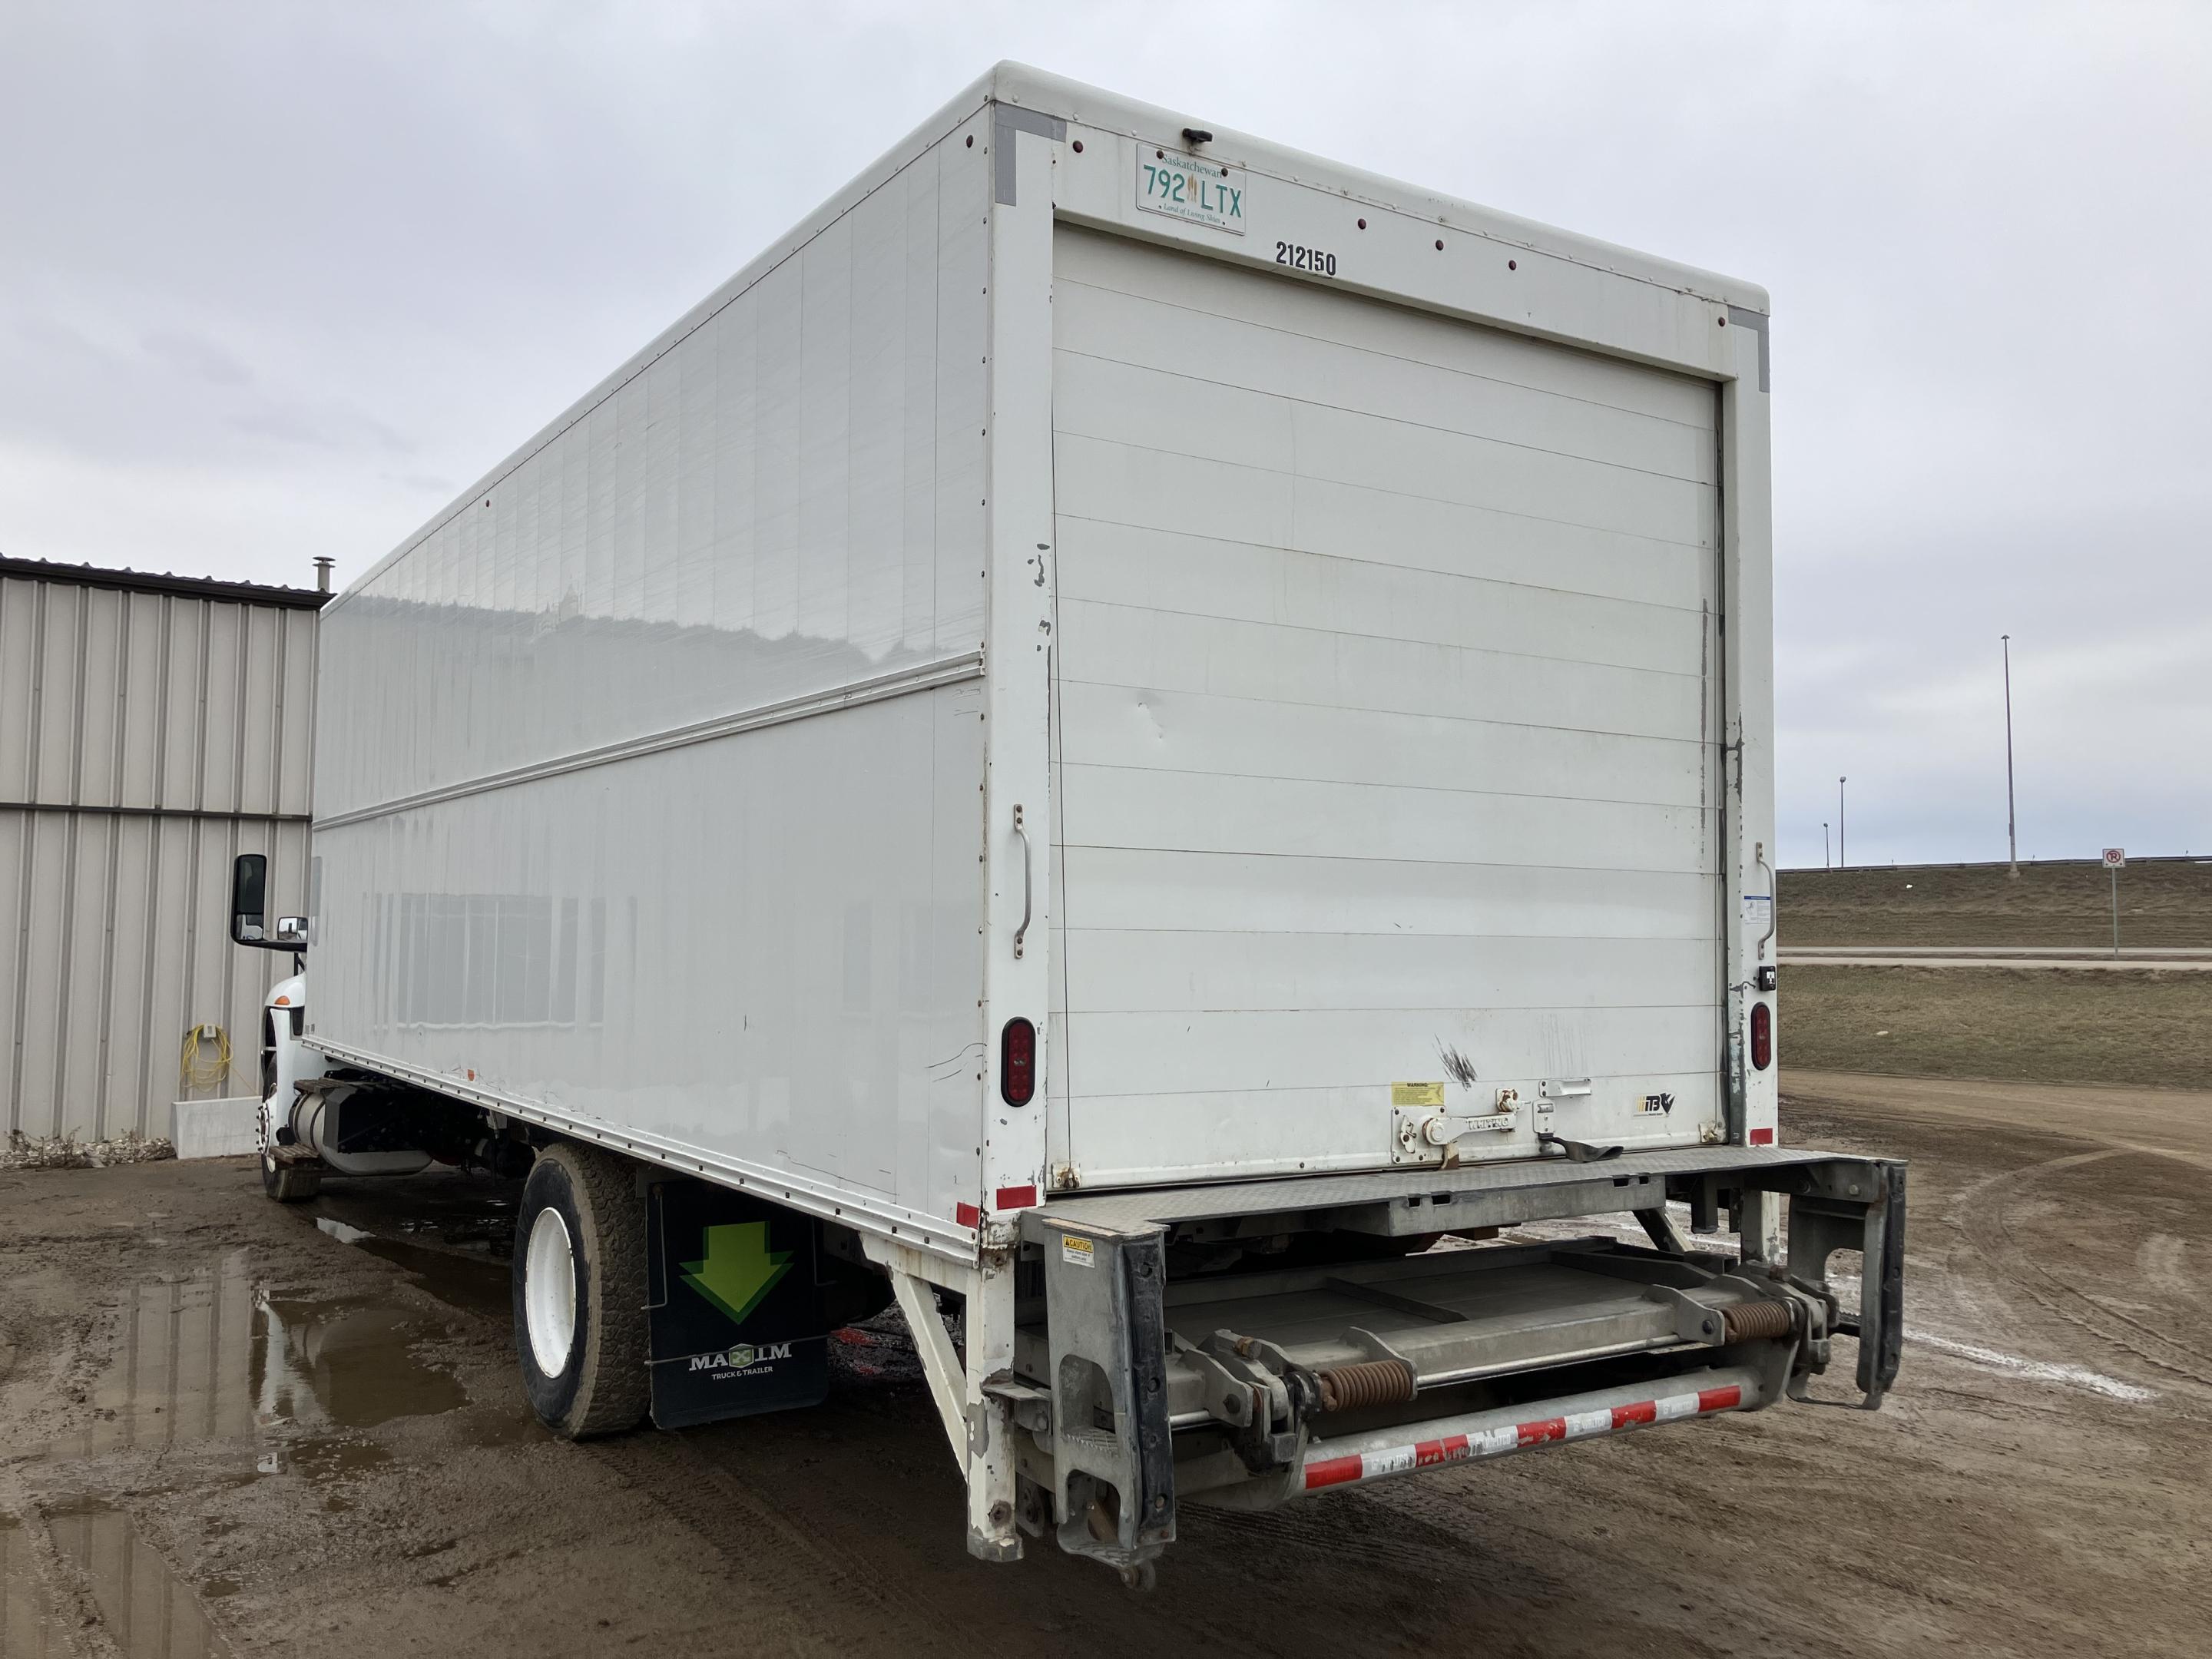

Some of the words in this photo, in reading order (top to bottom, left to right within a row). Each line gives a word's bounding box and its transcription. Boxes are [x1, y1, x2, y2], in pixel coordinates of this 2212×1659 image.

[1161, 154, 1223, 179] Saskatchewan
[1143, 164, 1185, 204] 792
[1200, 180, 1242, 218] LTX
[1164, 203, 1179, 213] Land
[1276, 240, 1336, 276] 212150
[1468, 1117, 1509, 1131] WHITING
[1069, 1239, 1092, 1251] CAUTION
[689, 1343, 793, 1372] MAXIM
[711, 1370, 737, 1380] TRUCK
[742, 1366, 773, 1376] TRAILER
